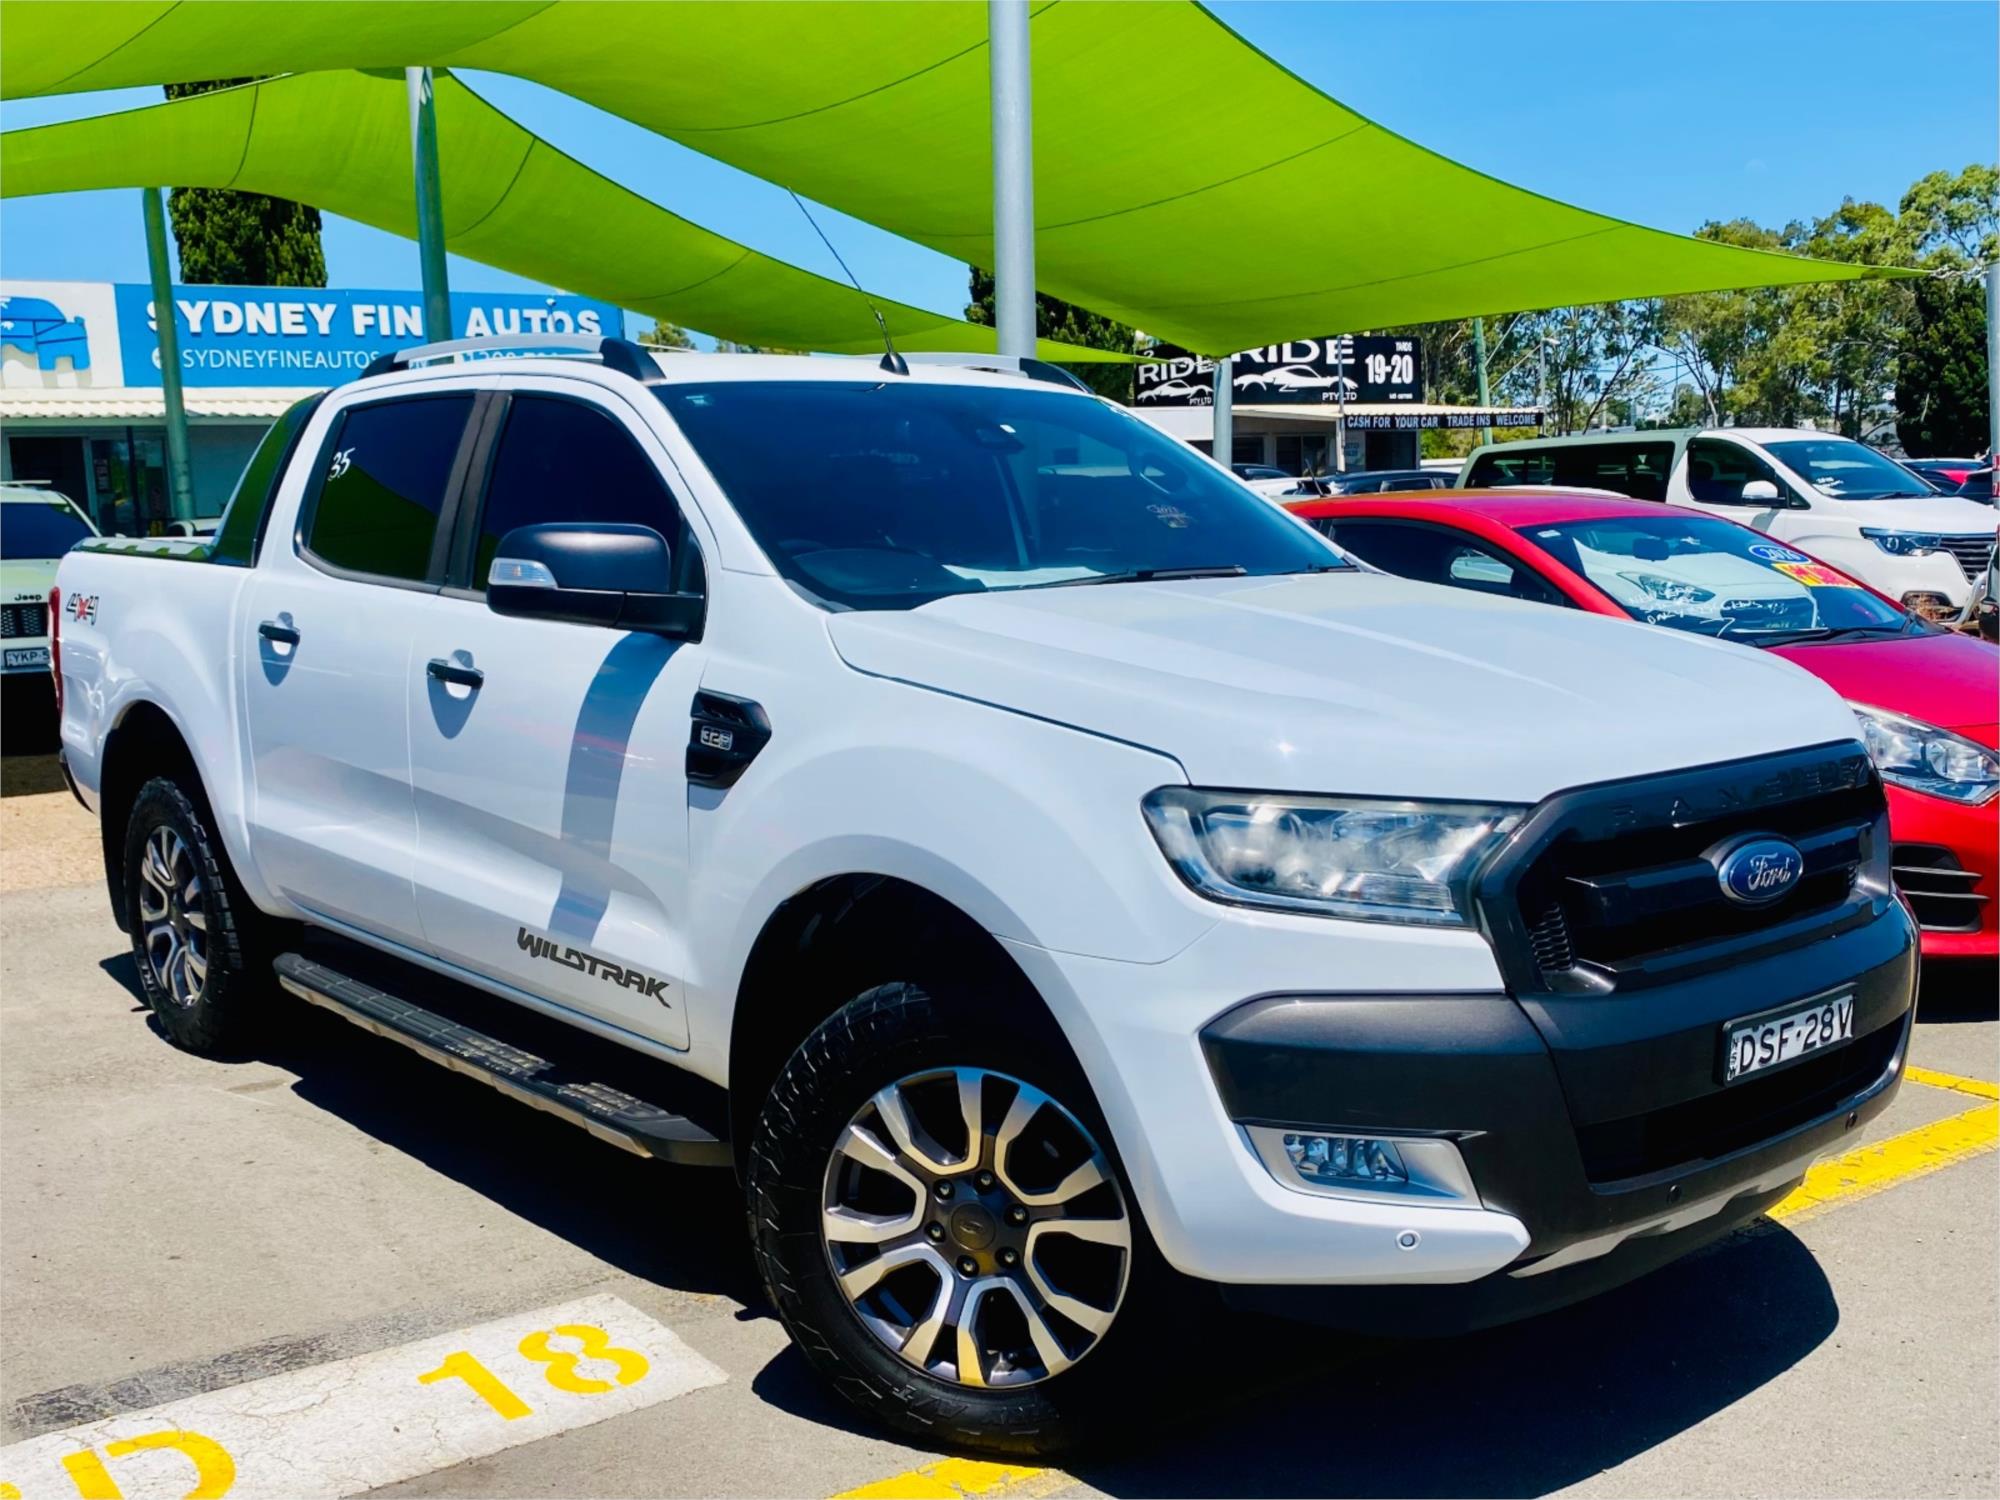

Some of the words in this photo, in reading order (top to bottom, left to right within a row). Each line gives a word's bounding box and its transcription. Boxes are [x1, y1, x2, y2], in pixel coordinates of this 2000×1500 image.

[352, 304, 424, 337] FIN
[465, 307, 602, 336] AUTOS
[1138, 355, 1215, 385] RIDE
[1364, 353, 1414, 384] 19-20
[1322, 392, 1338, 401] PTY
[1342, 392, 1357, 401] LTD
[1347, 416, 1370, 428] CASH
[1372, 416, 1391, 428] FOR
[1394, 416, 1418, 428] YOUR
[1420, 416, 1439, 427] CAR
[1446, 415, 1475, 427] TRADE
[1476, 414, 1491, 427] INS
[1496, 414, 1537, 426] WELCOME
[328, 447, 356, 481] 35
[14, 593, 42, 601] Jeep
[1747, 852, 1794, 891] Ford
[517, 926, 672, 1009] WILDTRAK
[417, 1323, 651, 1421] 18
